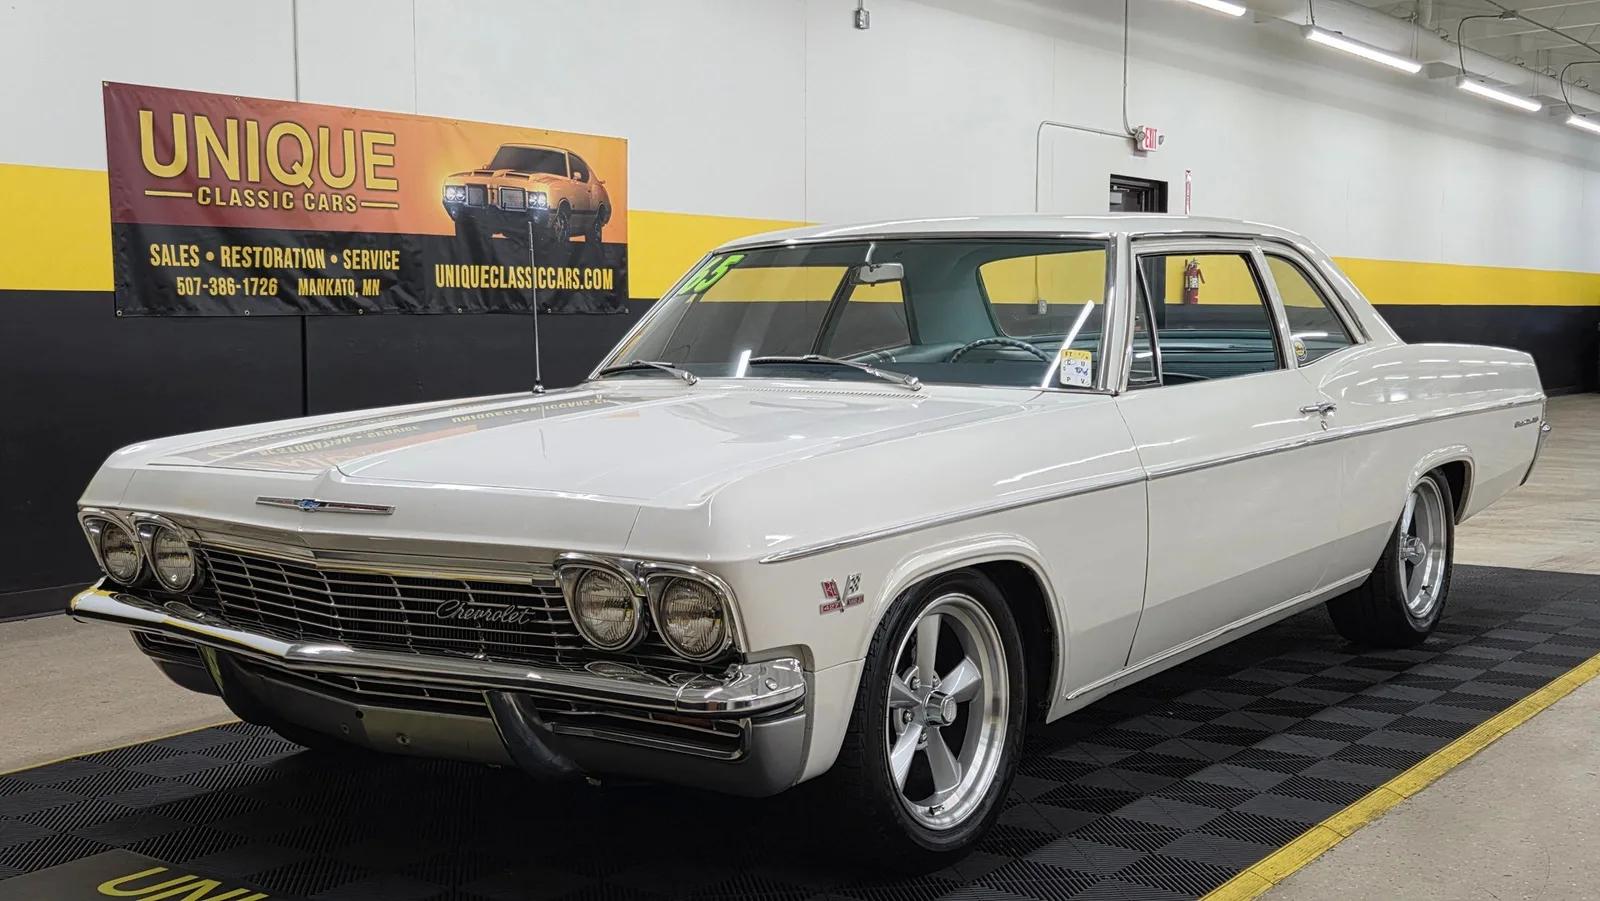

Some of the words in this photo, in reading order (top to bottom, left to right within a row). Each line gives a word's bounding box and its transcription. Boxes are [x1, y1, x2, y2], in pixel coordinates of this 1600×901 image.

[139, 110, 398, 191] UNIQUE
[198, 186, 295, 209] CLASSIC
[304, 193, 358, 212] CARS
[150, 243, 200, 268] SALES
[220, 246, 326, 269] RESTORATION
[343, 249, 400, 270] SERVICE
[176, 276, 279, 296] 507-386-1726
[298, 278, 359, 298] MANKATO,
[362, 279, 381, 296] MN
[435, 264, 614, 290] UNIQUECLASSICCARS.COM
[436, 600, 536, 624] Chevrolet
